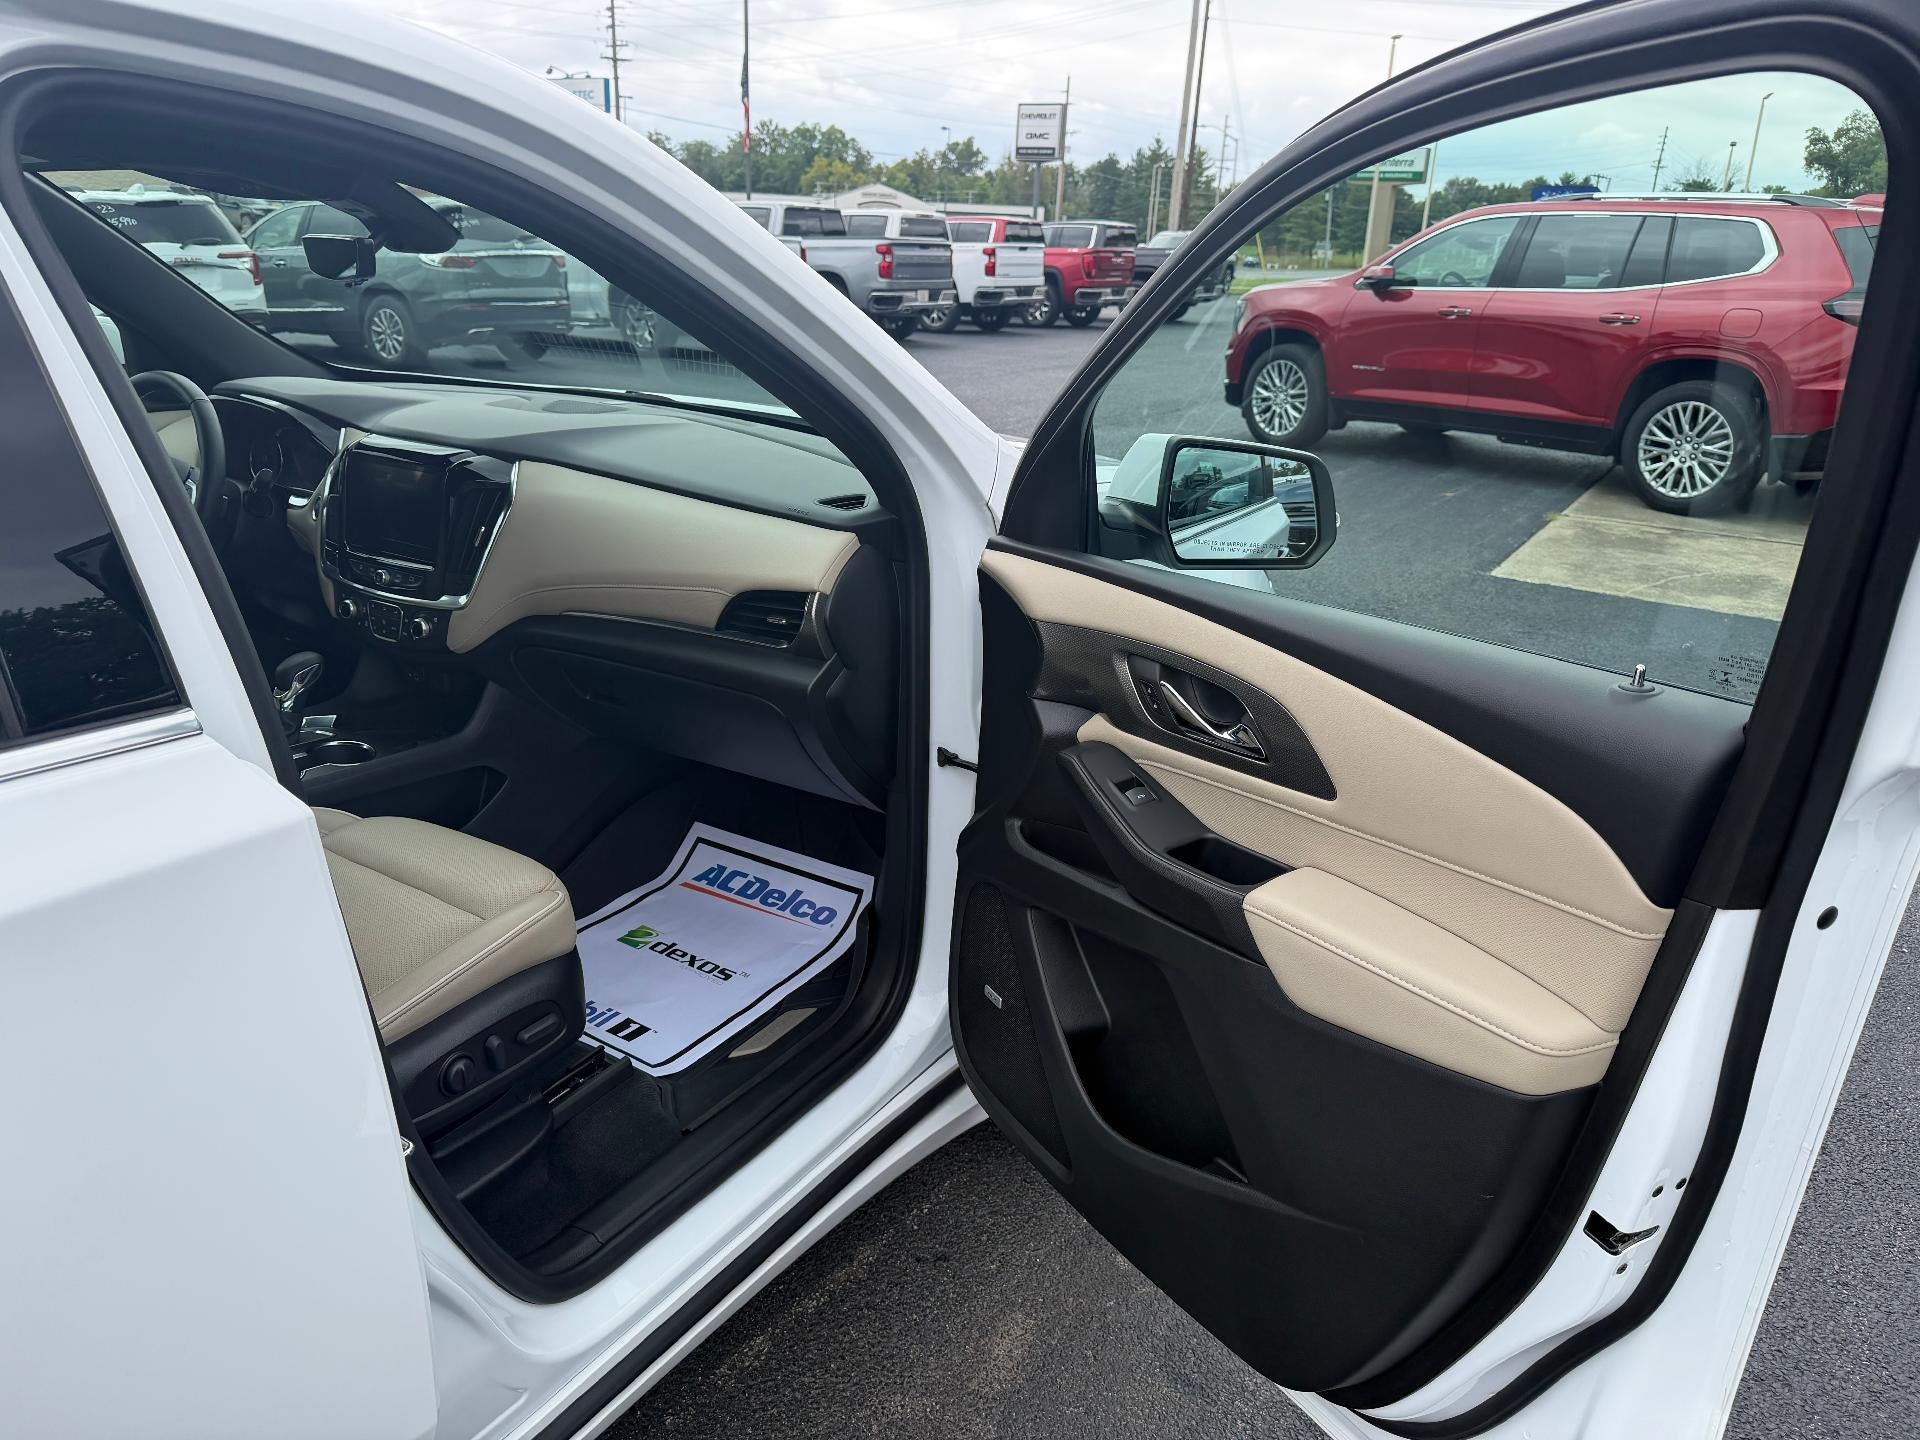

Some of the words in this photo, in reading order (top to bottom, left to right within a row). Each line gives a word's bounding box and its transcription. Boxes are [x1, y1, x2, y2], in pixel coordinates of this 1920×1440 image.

[1025, 132, 1050, 140] GMC
[1380, 158, 1415, 167] anterra
[1193, 538, 1218, 546] OBJECTS
[691, 863, 838, 926] ACDelco
[648, 941, 737, 981] dexos
